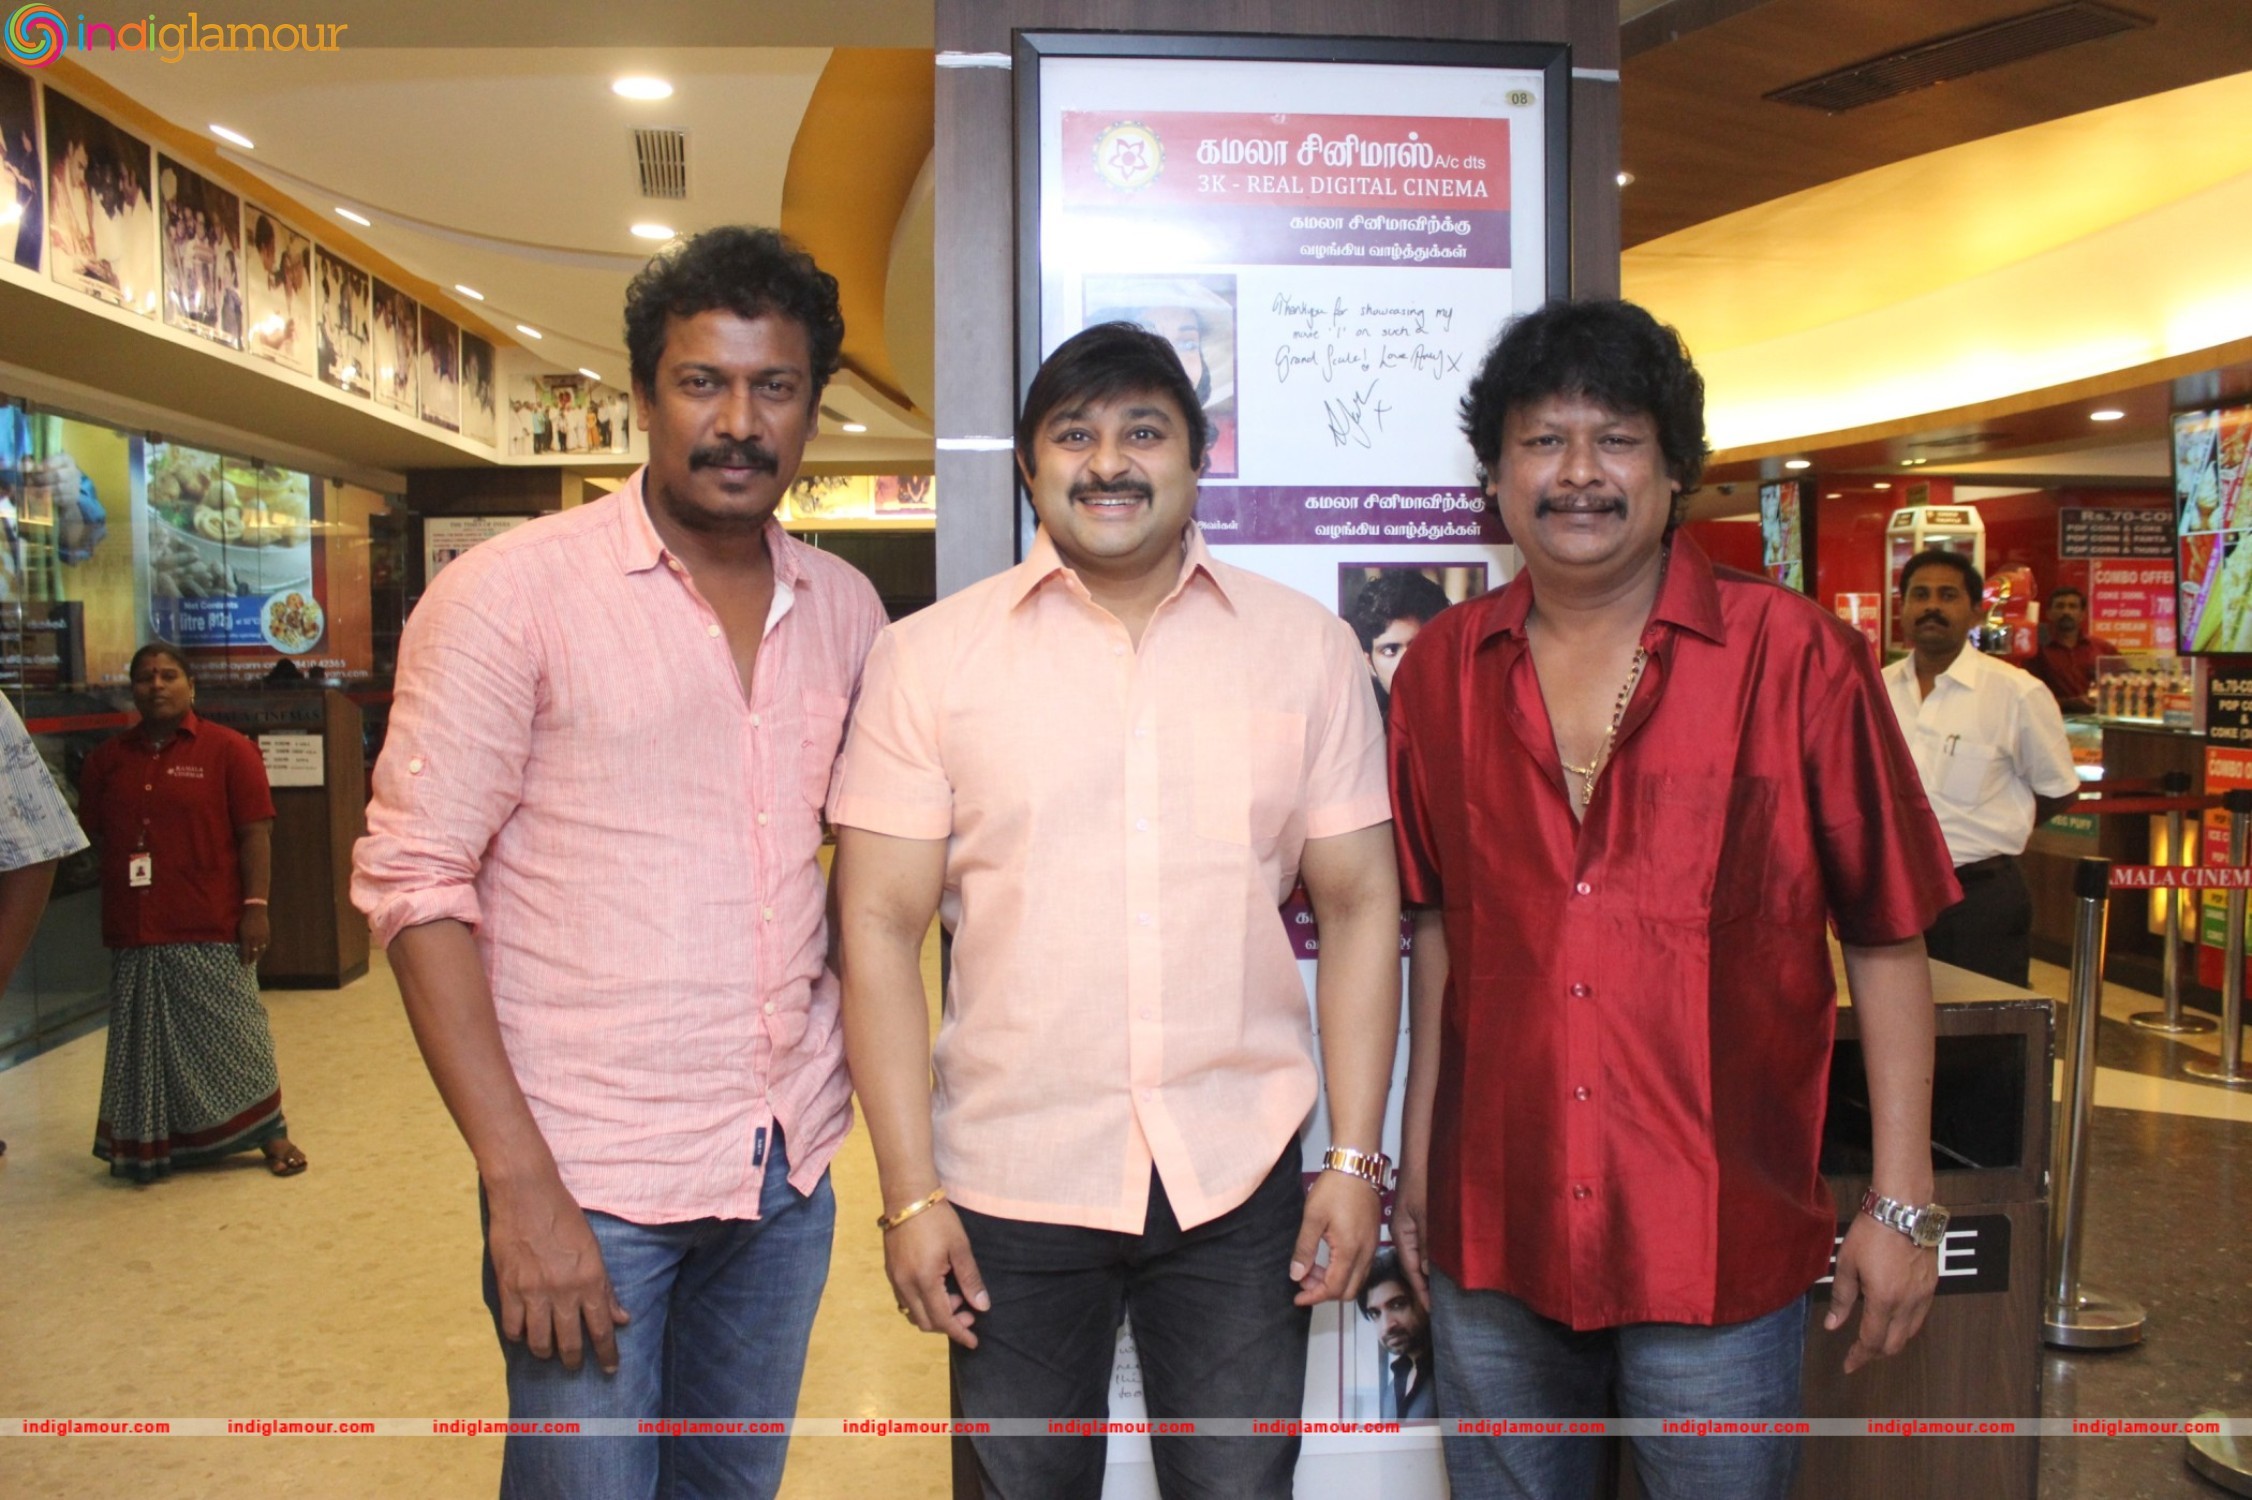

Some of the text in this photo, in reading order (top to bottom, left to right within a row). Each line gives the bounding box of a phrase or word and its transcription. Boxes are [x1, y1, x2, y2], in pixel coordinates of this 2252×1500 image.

[1511, 92, 1528, 105] 08
[1197, 131, 1434, 169] கமலா சினிமாஸ்
[1435, 155, 1486, 169] A/c dts
[1198, 175, 1226, 193] 3K
[1248, 176, 1303, 194] REAL
[1311, 176, 1397, 195] DIGITAL
[1403, 178, 1488, 198] CINEMA
[1290, 215, 1343, 230] கமலா
[1300, 242, 1467, 261] வழங்கிய வாழ்த்துக்கள்
[1360, 303, 1425, 328] showcasing
[1435, 307, 1453, 332] my
[1355, 328, 1370, 337] on
[1381, 325, 1409, 337] such
[1305, 494, 1359, 509] கமலா
[1315, 521, 1481, 541] வழங்கிய வாழ்த்துக்கள்
[2095, 570, 2138, 584] COMBO
[181, 612, 206, 632] litre
[2219, 700, 2240, 711] POP
[2210, 727, 2238, 738] COKE
[2208, 759, 2243, 777] COMBO
[2108, 868, 2175, 886] MALA
